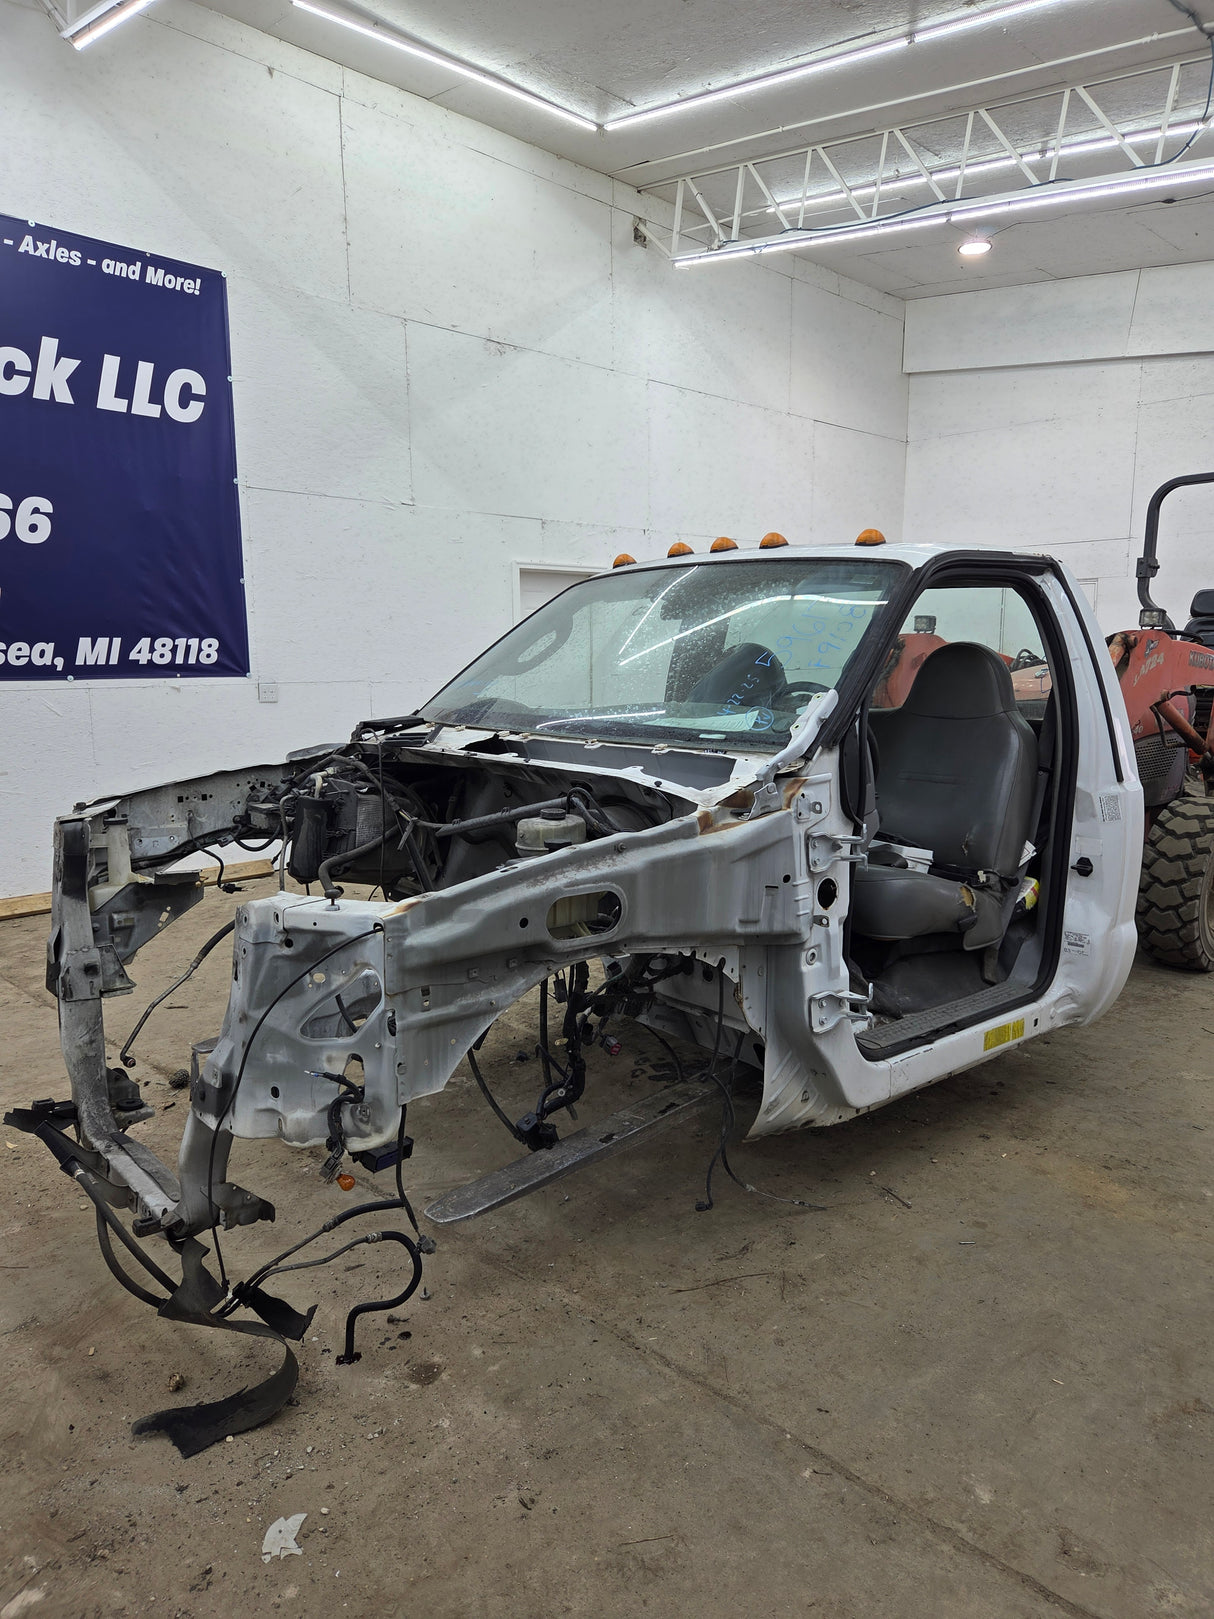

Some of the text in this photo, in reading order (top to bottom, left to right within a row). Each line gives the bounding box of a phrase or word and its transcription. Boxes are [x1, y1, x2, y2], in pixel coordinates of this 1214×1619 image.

[18, 234, 82, 266] Axles
[101, 258, 142, 281] and
[145, 266, 202, 296] More!
[0, 335, 207, 423] ck LLC
[75, 637, 122, 665] MI
[129, 637, 220, 665] 48118
